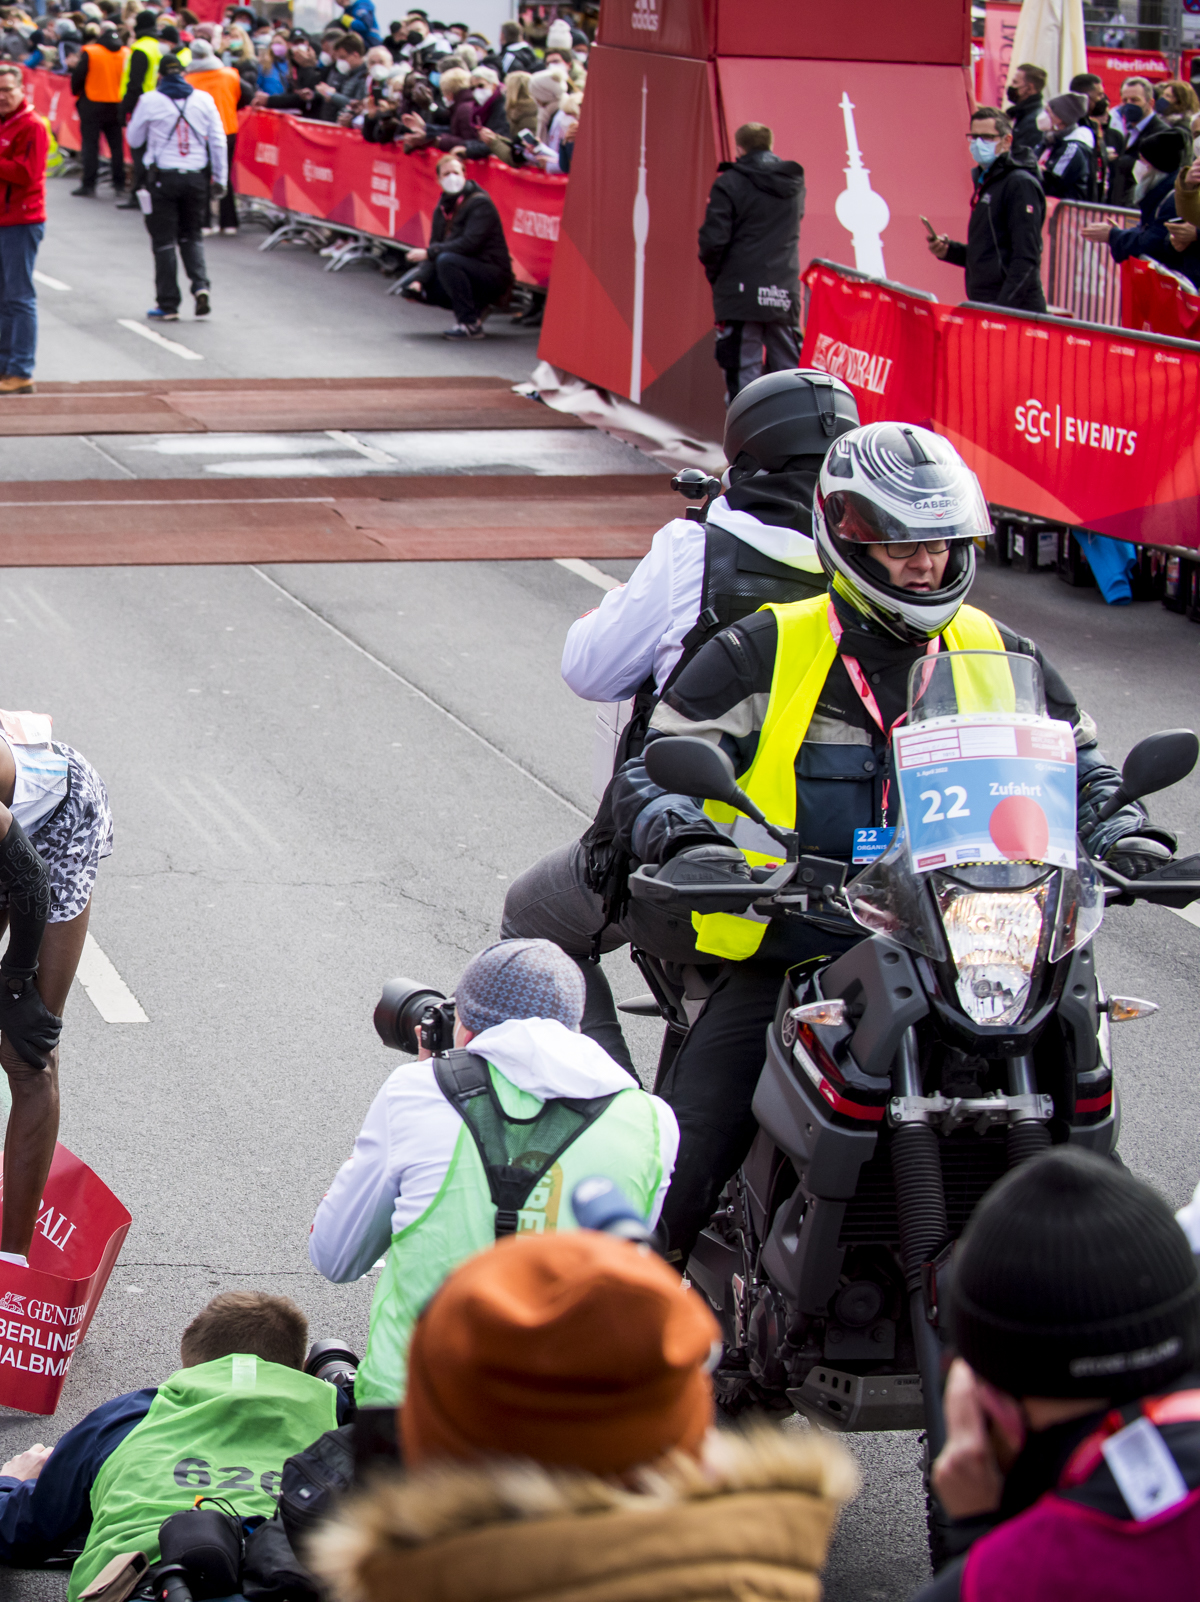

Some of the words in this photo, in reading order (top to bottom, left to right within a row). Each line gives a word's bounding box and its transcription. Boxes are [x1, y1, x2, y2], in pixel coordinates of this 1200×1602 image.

[757, 296, 792, 312] timing
[1065, 416, 1137, 456] EVENTS
[914, 499, 958, 510] CABERG
[989, 782, 1042, 797] Zufahrt
[919, 785, 970, 824] 22
[857, 830, 877, 842] 22
